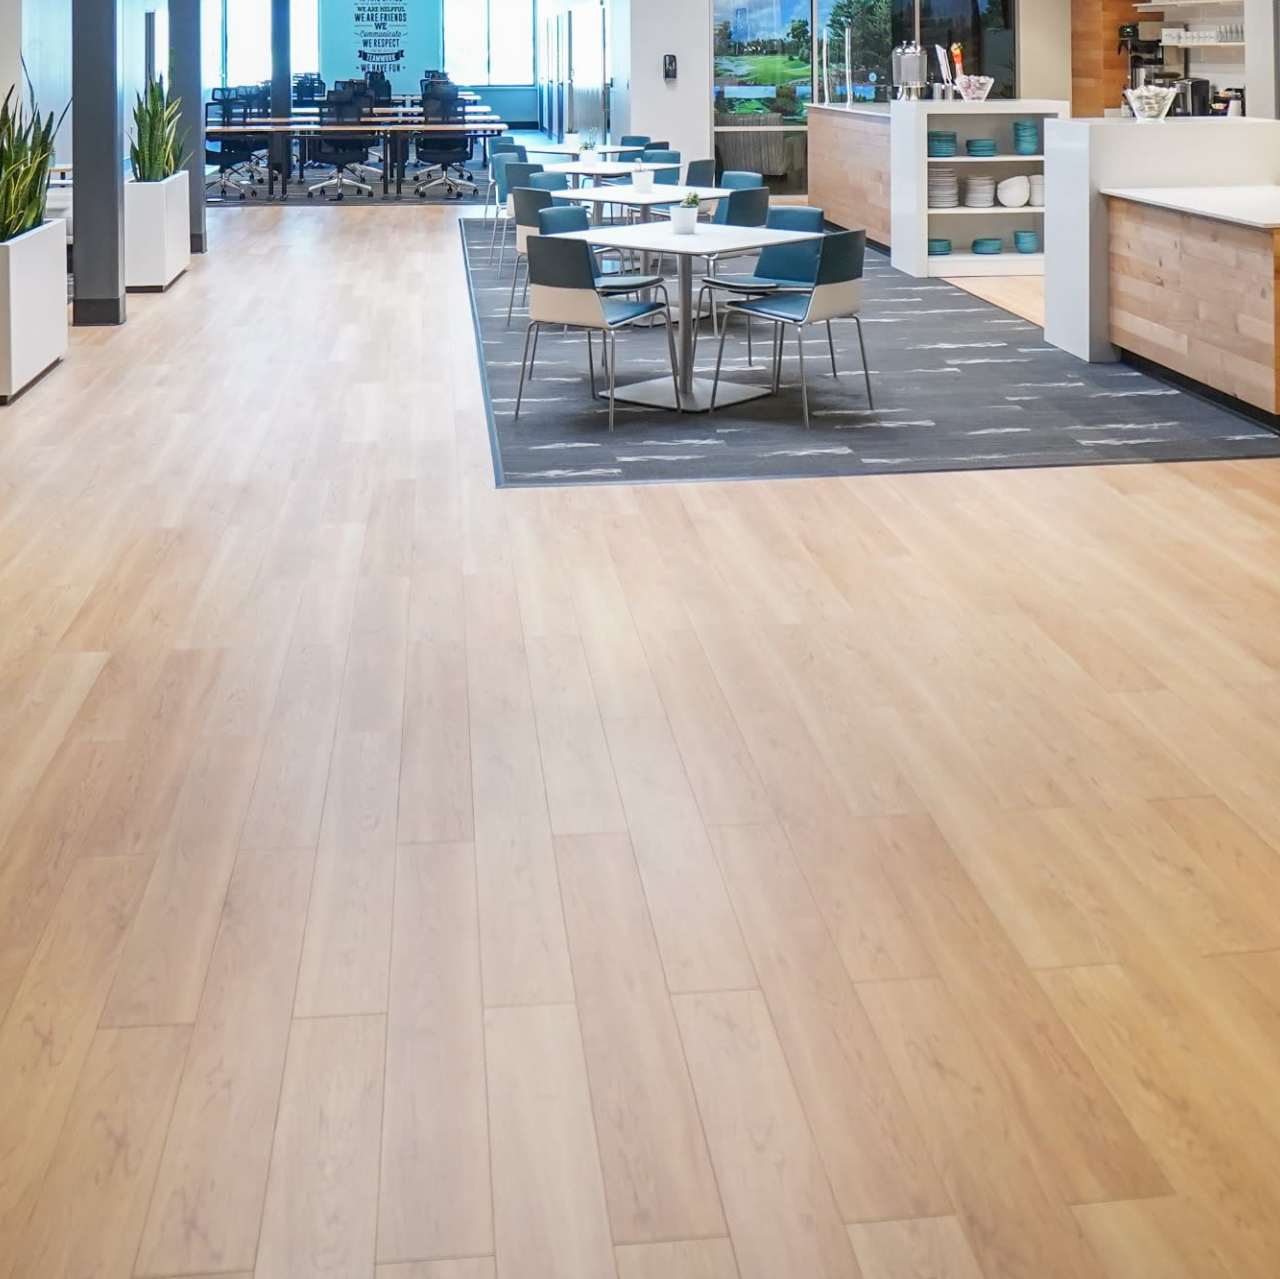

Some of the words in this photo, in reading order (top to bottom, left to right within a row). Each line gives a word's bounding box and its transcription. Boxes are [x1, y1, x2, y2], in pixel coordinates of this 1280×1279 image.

[354, 13, 365, 22] WE
[366, 13, 379, 22] ARE
[380, 13, 407, 22] FRIENDS
[362, 38, 372, 48] WE
[373, 38, 400, 48] RESPECT
[360, 63, 371, 73] WE
[372, 63, 387, 73] HAVE
[388, 63, 401, 72] FUN
